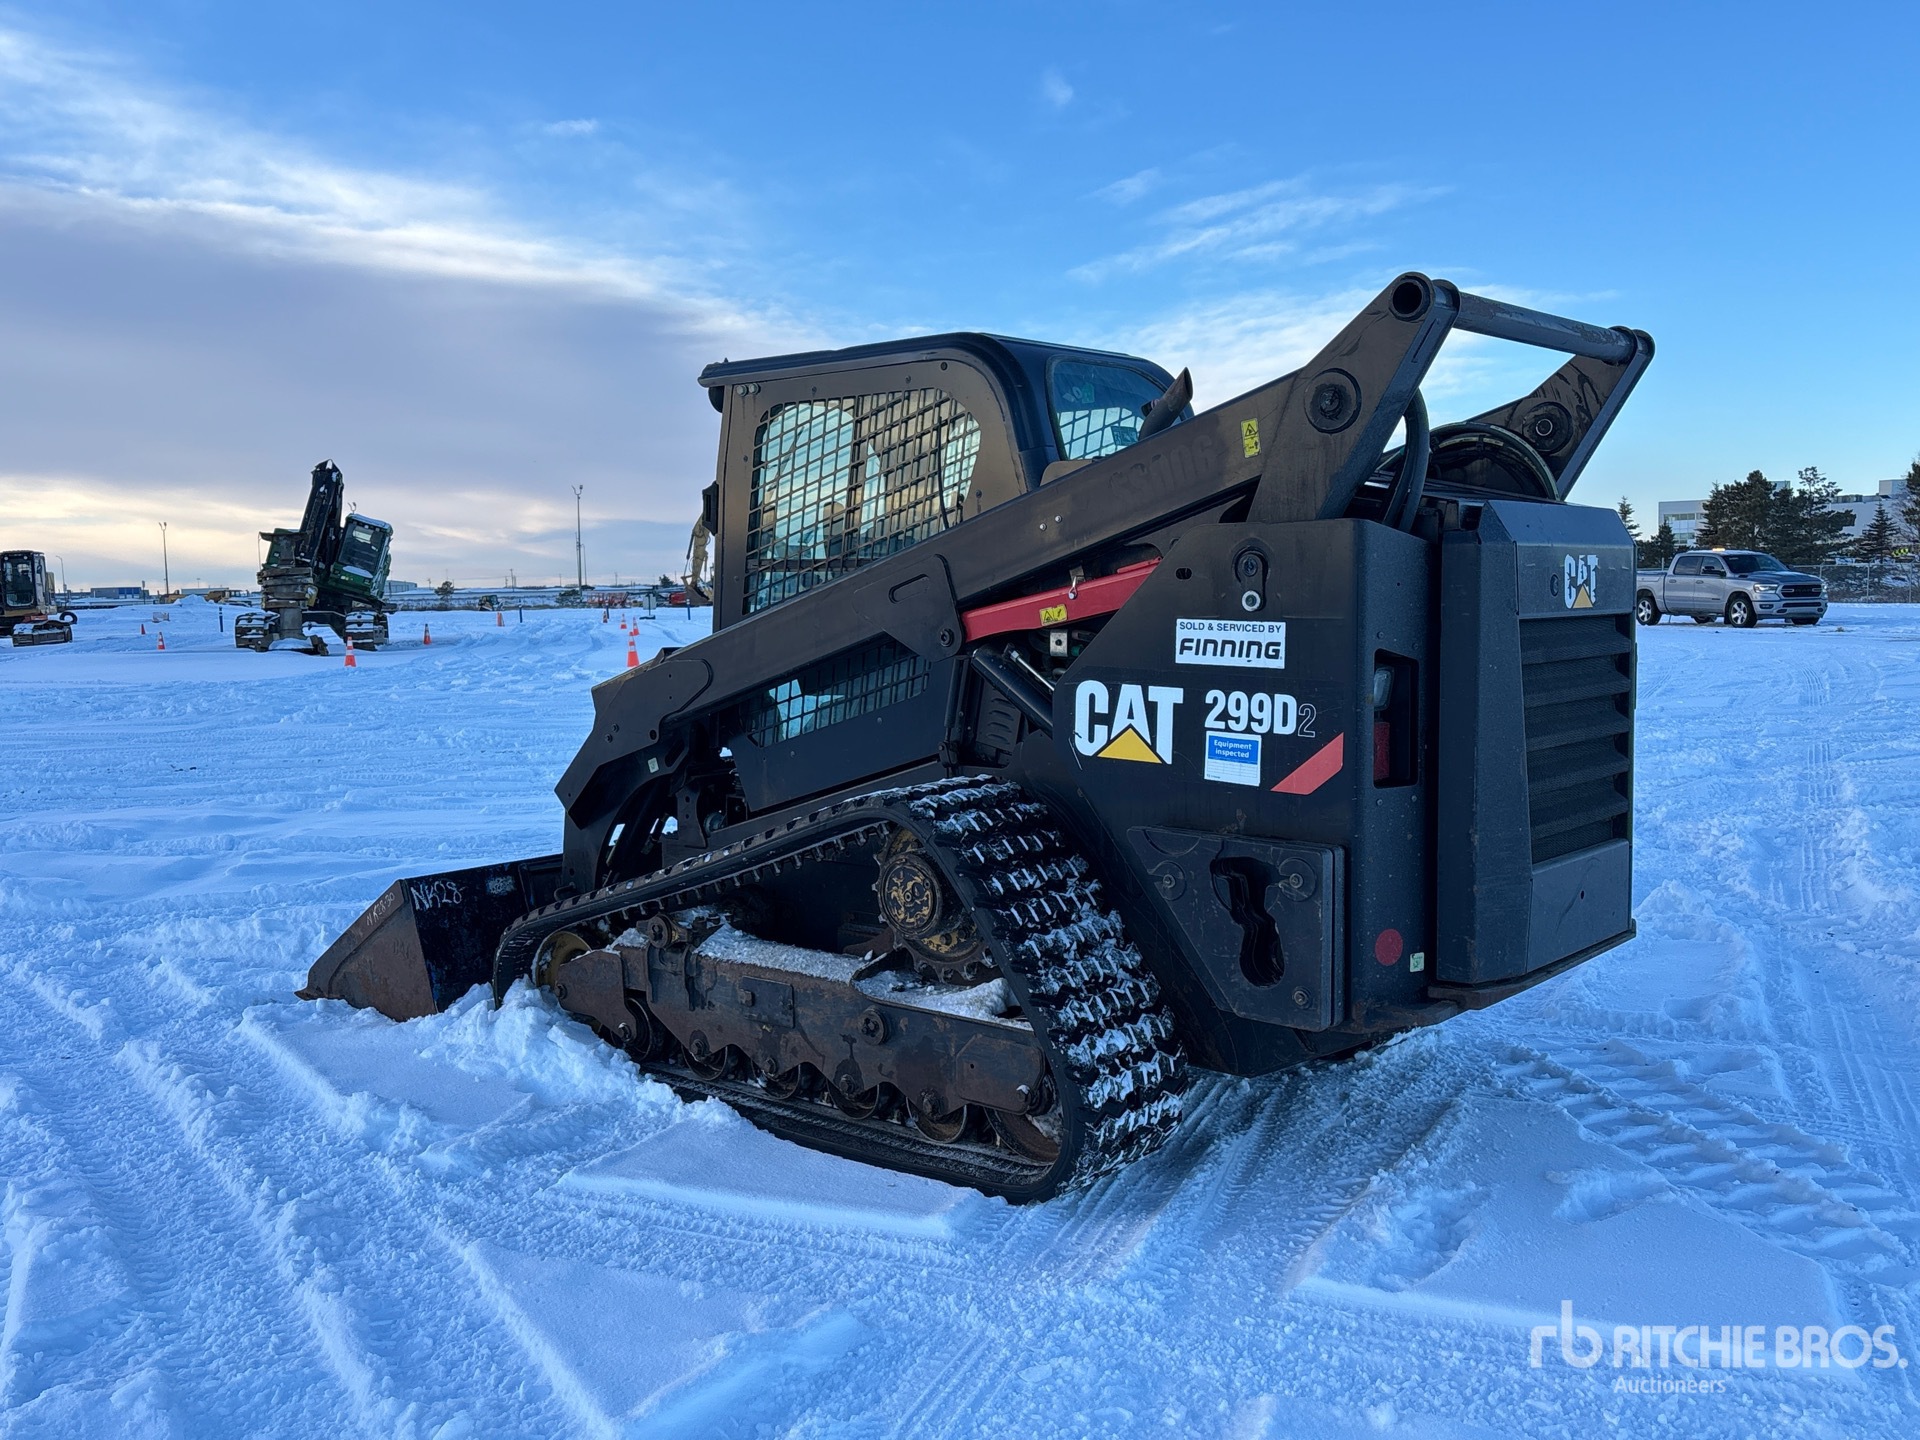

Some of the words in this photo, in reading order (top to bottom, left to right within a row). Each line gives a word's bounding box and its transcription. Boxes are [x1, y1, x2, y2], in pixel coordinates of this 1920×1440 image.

[1564, 553, 1599, 609] CAT
[1179, 622, 1205, 631] SOLD
[1207, 622, 1214, 631] &
[1216, 623, 1265, 633] SERVICED
[1268, 625, 1282, 633] BY
[1075, 680, 1184, 765] CAT
[1213, 739, 1252, 750] Equipment
